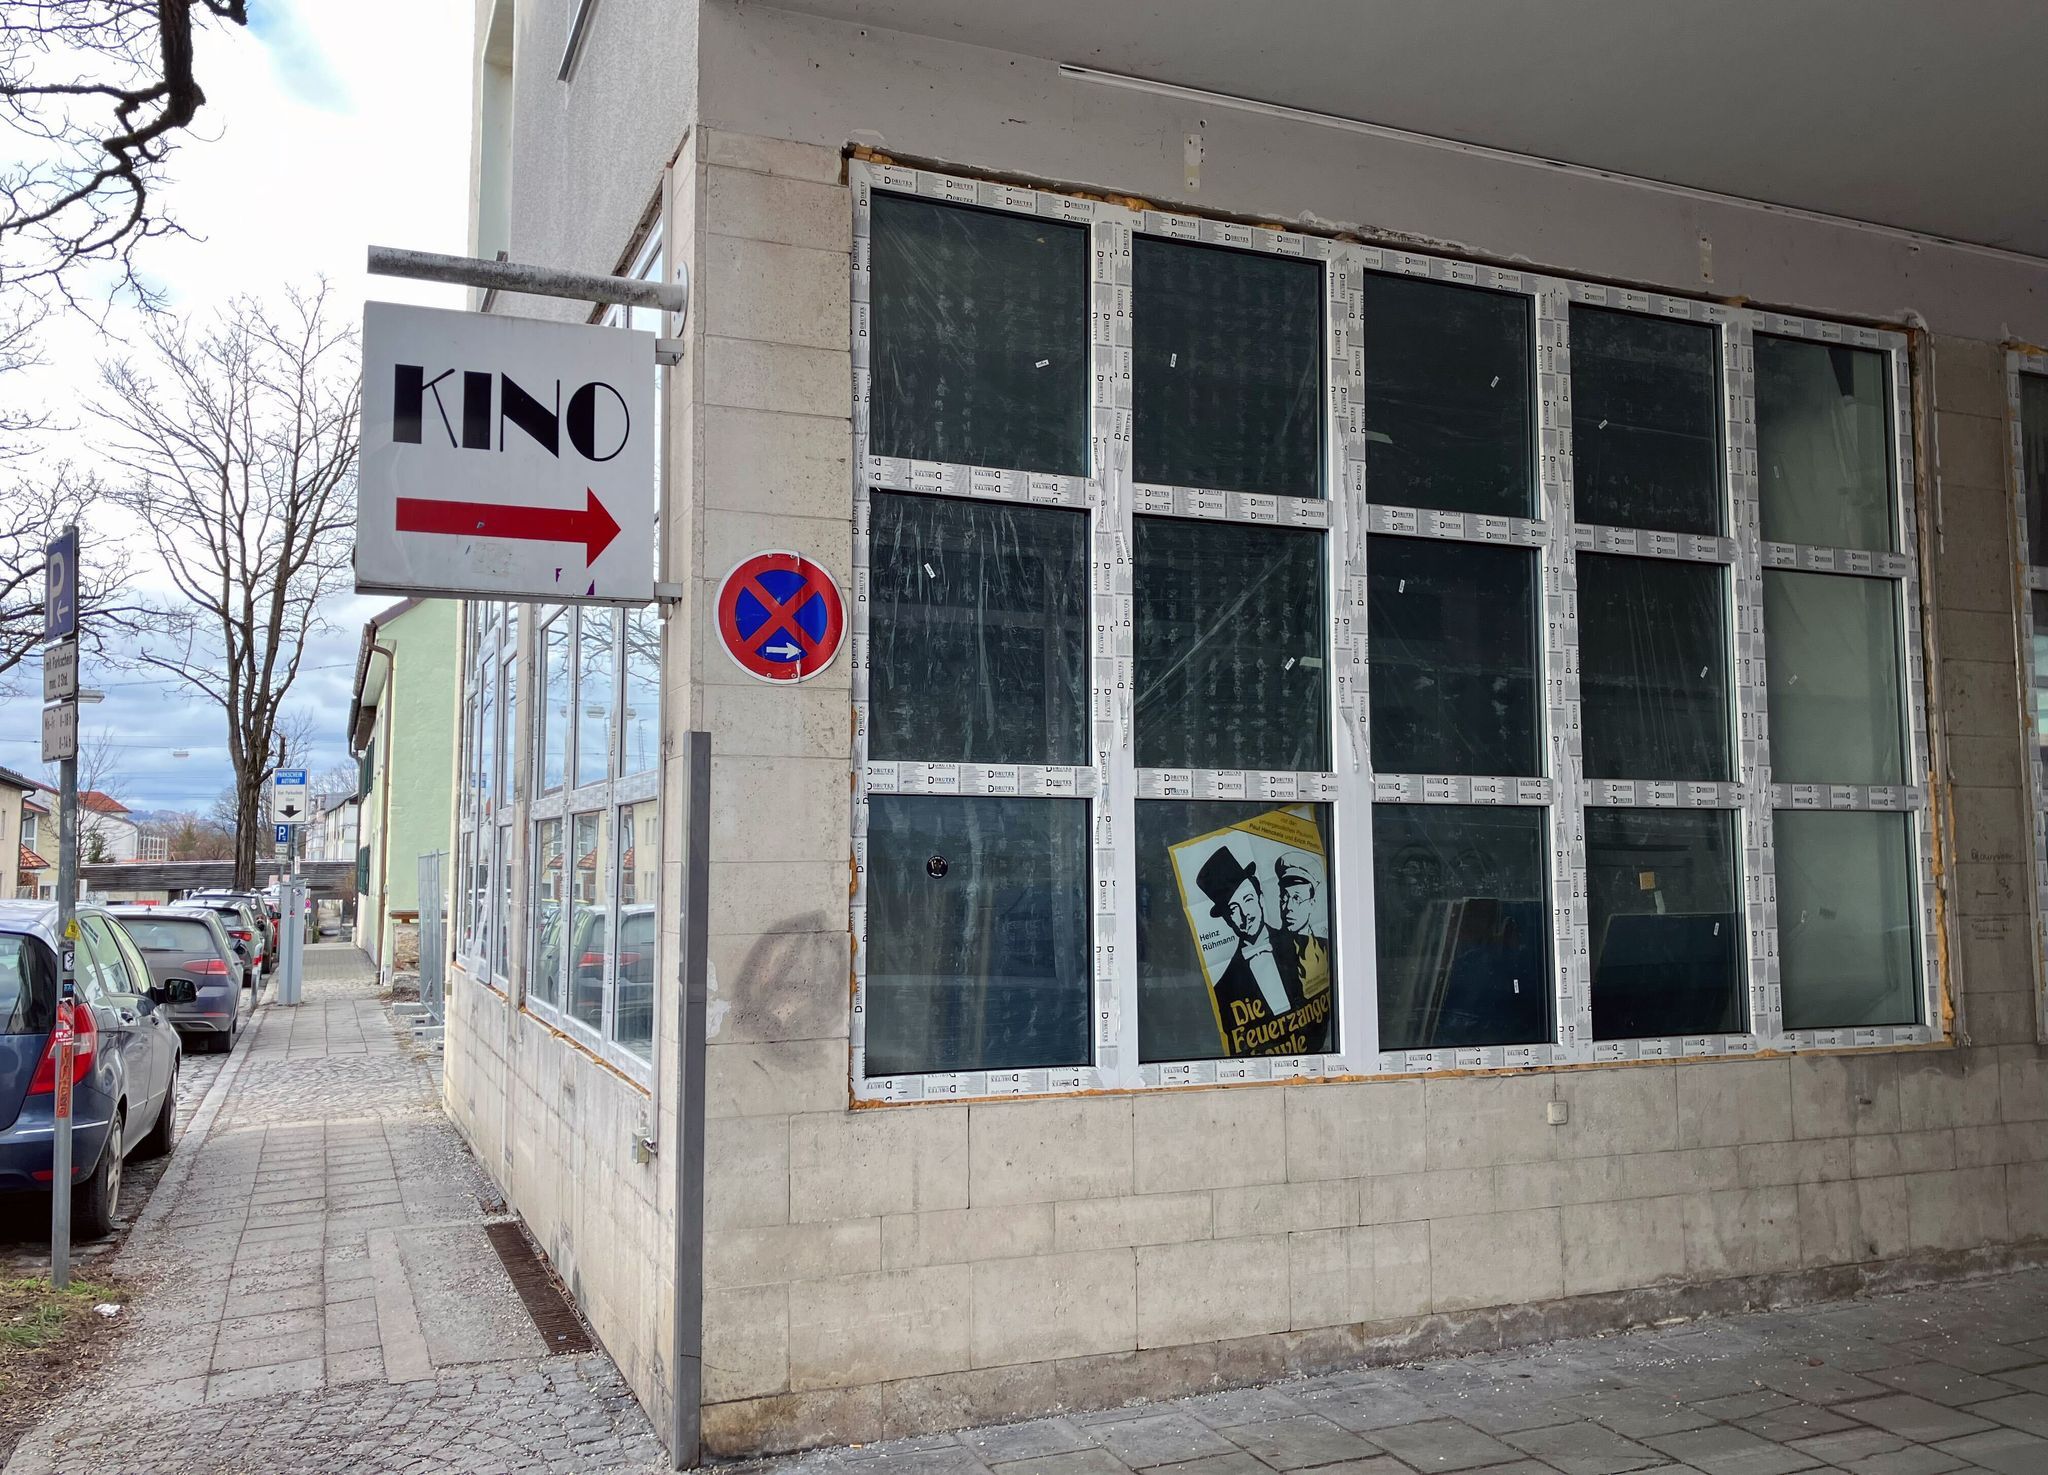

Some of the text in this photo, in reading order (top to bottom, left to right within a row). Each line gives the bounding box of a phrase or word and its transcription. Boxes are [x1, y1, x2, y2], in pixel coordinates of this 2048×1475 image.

[393, 364, 630, 462] KINO
[49, 551, 64, 628] P
[278, 826, 286, 840] P
[1249, 823, 1260, 832] Paul
[1200, 928, 1220, 942] Heinz
[1202, 934, 1236, 952] Rühmann
[1230, 997, 1265, 1026] Die
